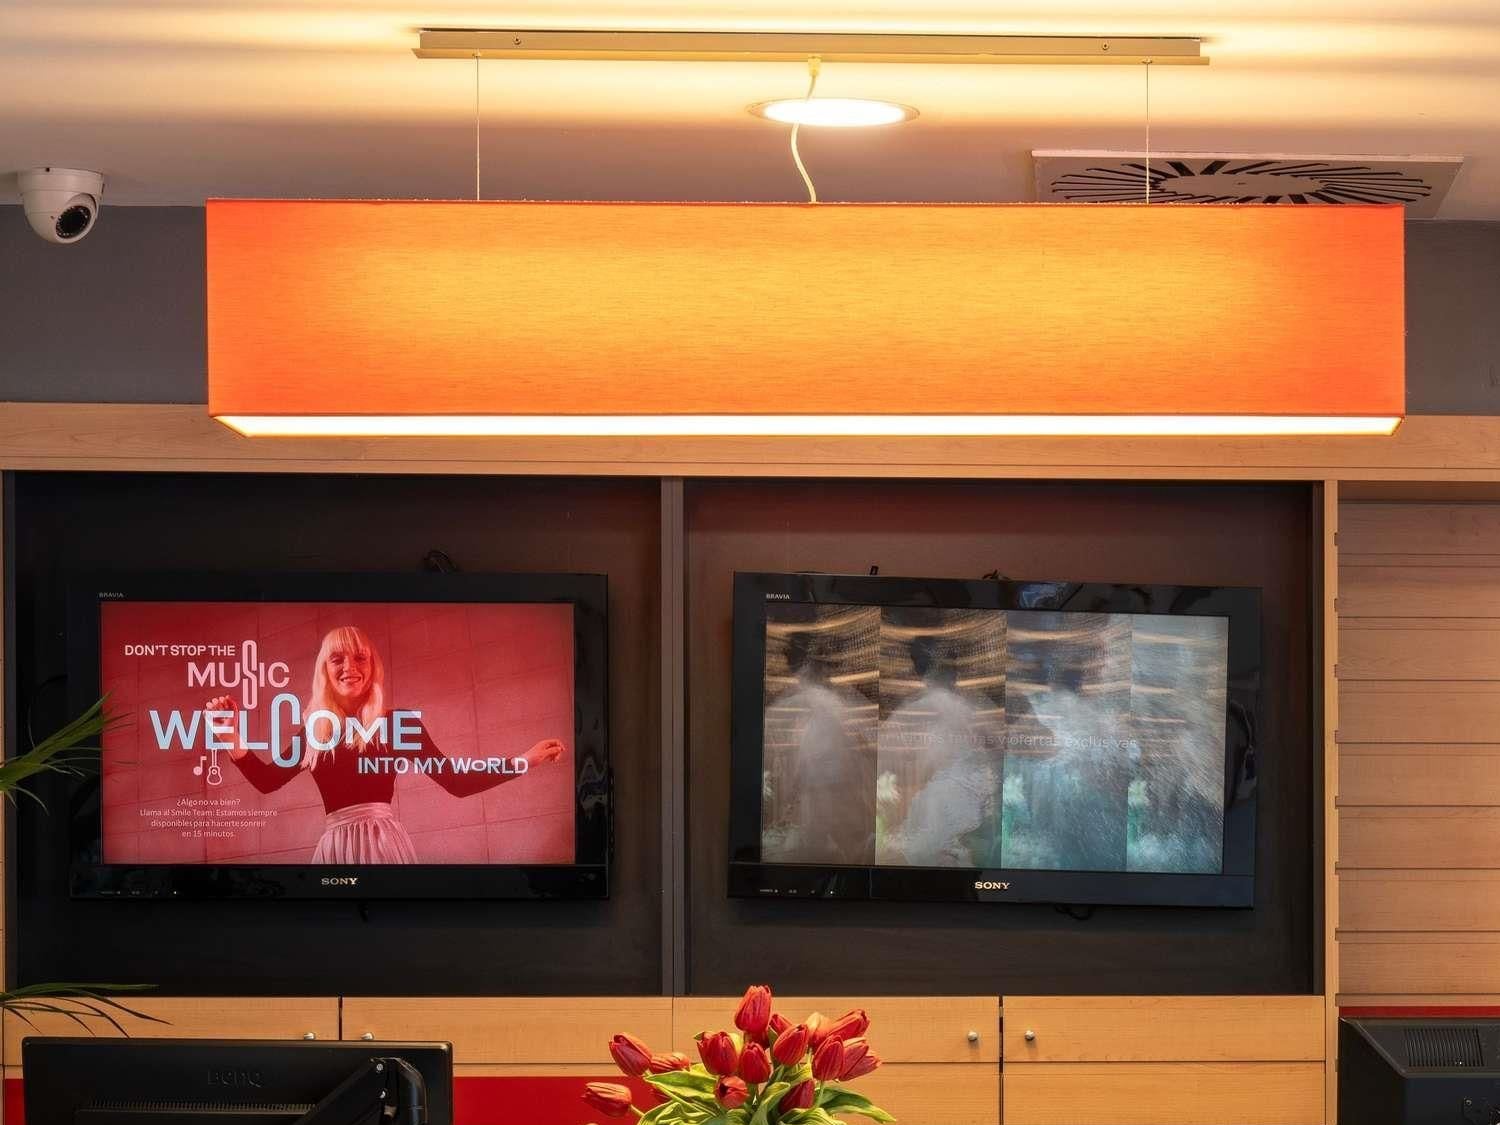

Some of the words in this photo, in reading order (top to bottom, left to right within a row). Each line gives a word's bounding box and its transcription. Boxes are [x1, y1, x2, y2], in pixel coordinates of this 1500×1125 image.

[124, 645, 168, 656] DON'T
[170, 645, 206, 656] STOP
[207, 645, 236, 656] THE
[187, 640, 290, 710] MUSIC
[149, 693, 422, 768] WELCOME
[358, 757, 409, 774] INTO
[414, 757, 447, 774] MY
[321, 877, 358, 886] SONY
[975, 881, 1010, 890] SONY
